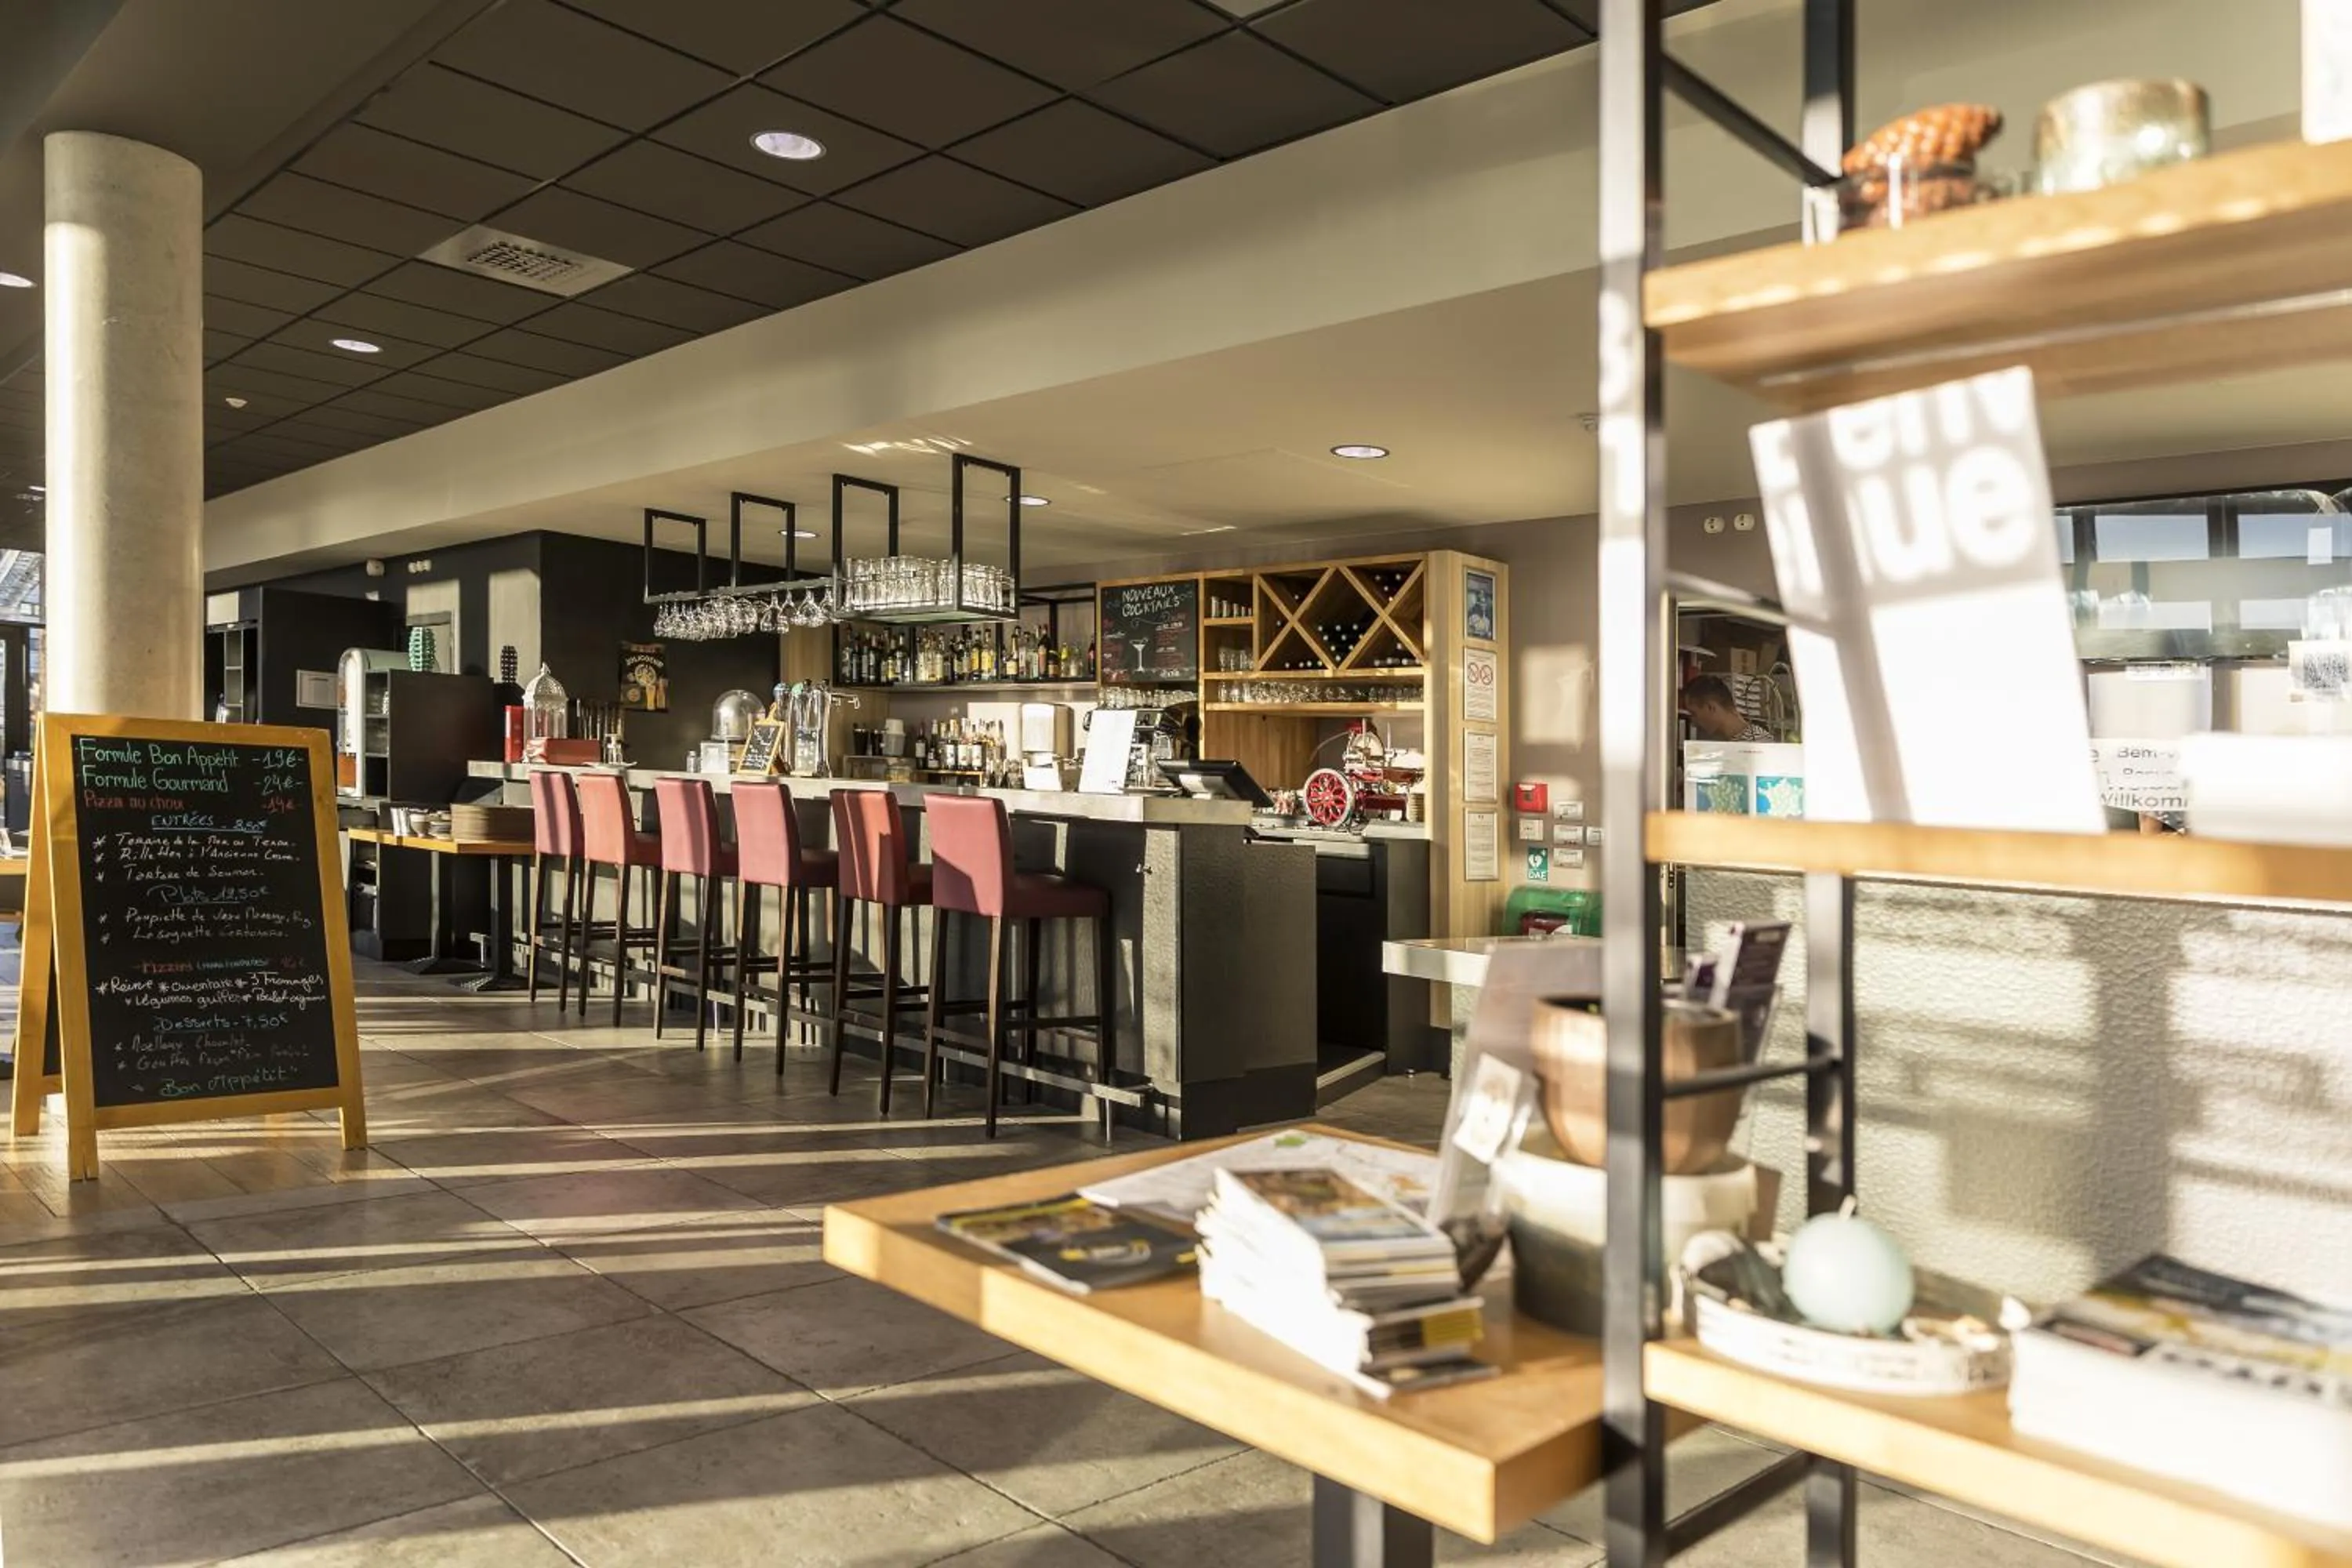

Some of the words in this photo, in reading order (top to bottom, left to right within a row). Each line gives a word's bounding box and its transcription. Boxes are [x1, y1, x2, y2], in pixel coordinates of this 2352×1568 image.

[1122, 585, 1175, 603] NOUVEAUX
[1122, 595, 1180, 617] COCKTAILS
[79, 737, 142, 765] Formule
[148, 743, 183, 765] Bon
[82, 764, 147, 789] Formule
[153, 767, 229, 793] Gourmand
[83, 790, 124, 808] Pizza
[130, 797, 146, 810] au
[186, 866, 199, 877] de
[192, 909, 205, 922] de
[111, 976, 154, 993] Reine
[263, 971, 324, 992] Fromages
[159, 1078, 201, 1097] Bon
